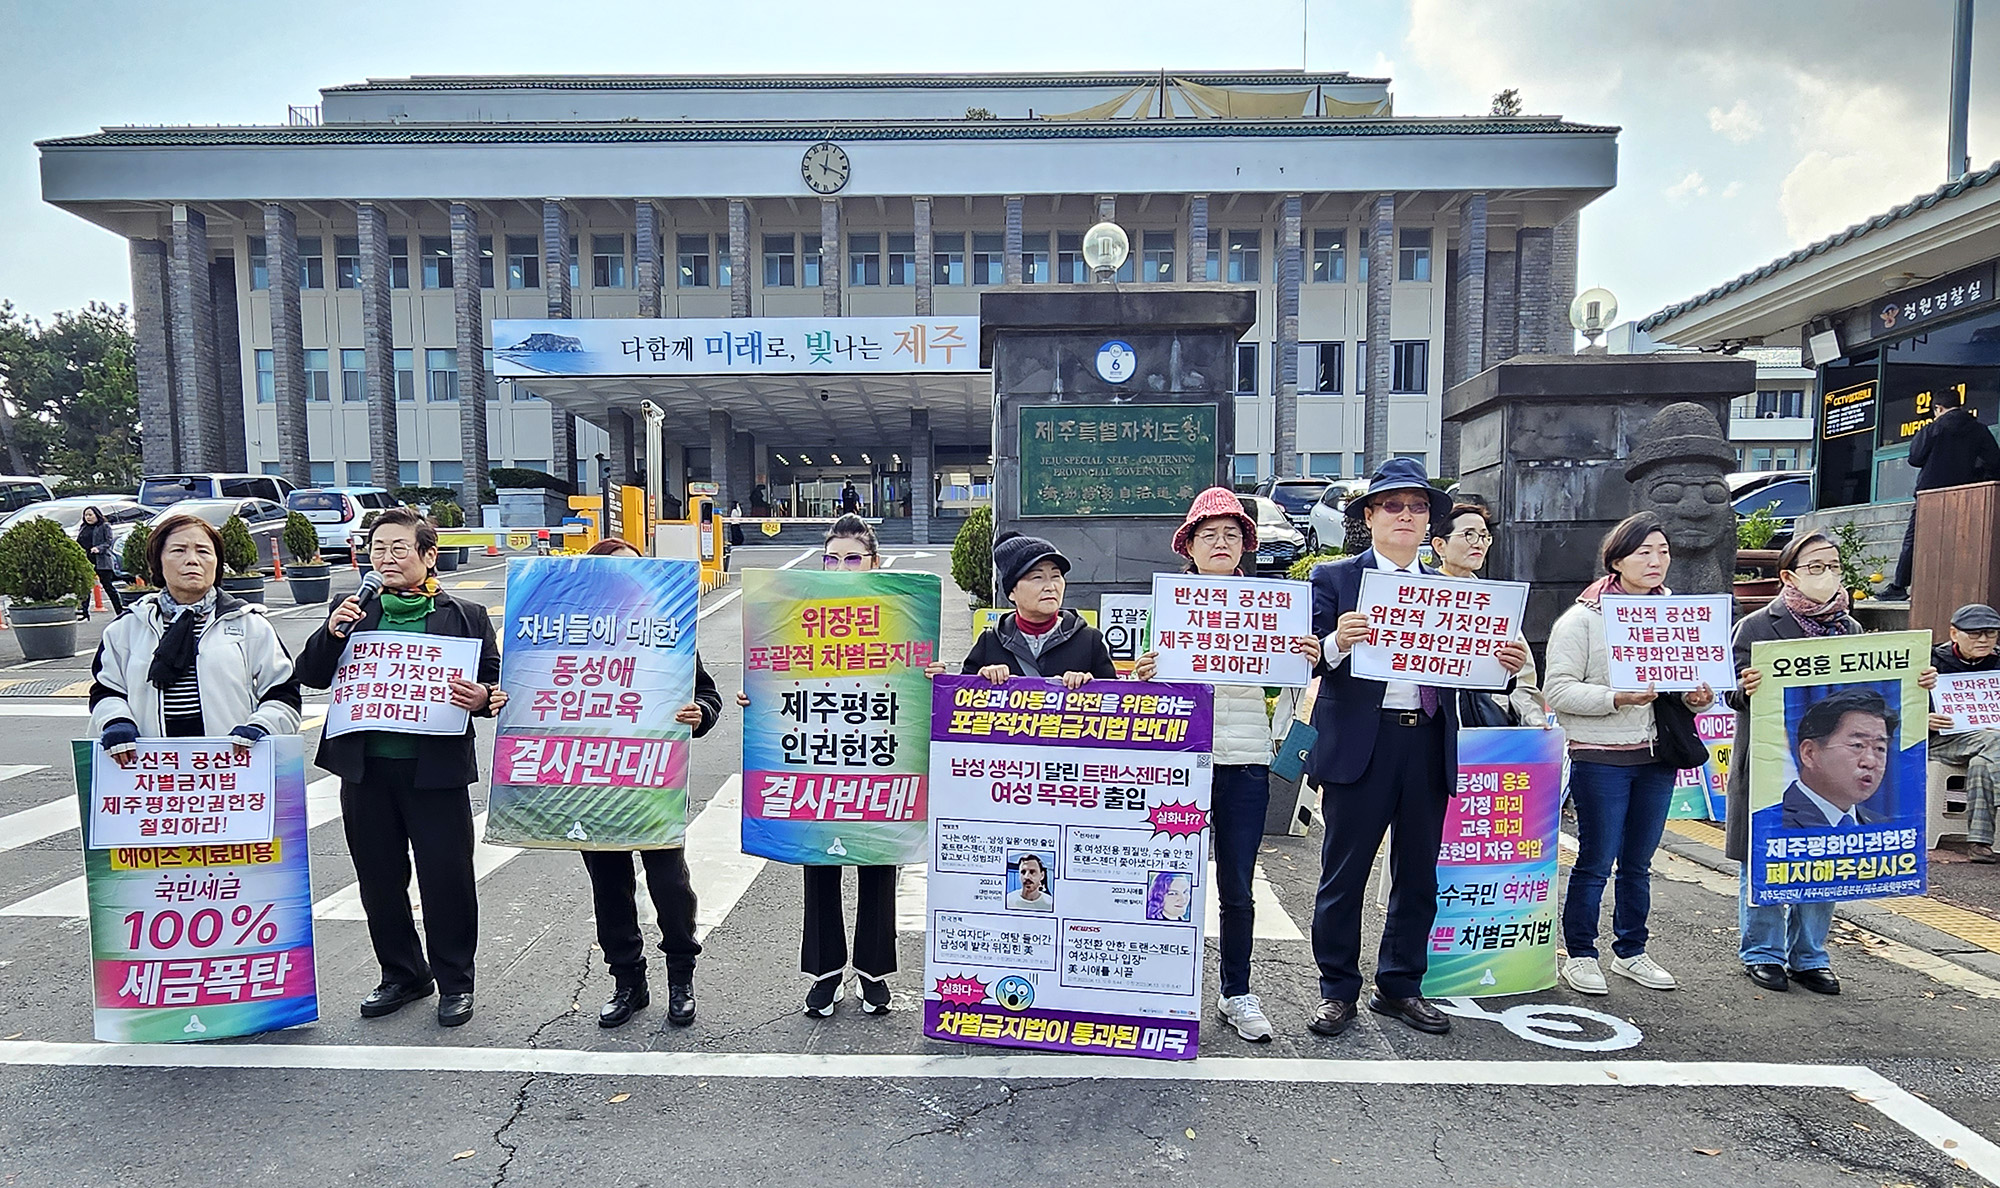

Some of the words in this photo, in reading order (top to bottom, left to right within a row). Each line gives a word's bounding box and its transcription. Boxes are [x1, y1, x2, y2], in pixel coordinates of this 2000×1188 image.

[1903, 280, 1982, 321] 청원경찰실
[620, 334, 695, 363] 다함께
[703, 329, 796, 367] 미래로,
[804, 330, 883, 366] 빛나는
[892, 323, 968, 366] 제주
[1112, 358, 1121, 371] 6
[1035, 419, 1202, 443] 제주특별자치도청
[1040, 456, 1062, 465] JEJU
[1064, 455, 1103, 465] SPECIAL
[1138, 455, 1196, 464] GOVERNING
[1053, 467, 1111, 477] PROVINCIAL
[1116, 466, 1183, 476] GOVERNMENT
[511, 535, 528, 546] 금지
[1174, 587, 1229, 606] 반신적
[1239, 589, 1293, 609] 공산화
[1398, 585, 1492, 612] 반자유민주
[801, 604, 881, 638] 위장된
[1187, 609, 1278, 632] 차별금지법
[1370, 604, 1427, 629] 위헌적
[1435, 611, 1511, 637] 거짓인권
[1616, 606, 1657, 623] 반신적
[1665, 606, 1713, 623] 공산화
[516, 612, 617, 646] 자녀들에
[627, 615, 681, 649] 대한
[1627, 626, 1701, 643] 차별금지법
[353, 642, 442, 662] 반자유민주
[1105, 625, 1144, 661] 입
[1158, 630, 1303, 654] 제주평화인권헌장
[748, 643, 815, 673] 포괄적
[820, 639, 935, 672] 차별금지법
[1192, 654, 1271, 675] 철회하라!
[1391, 652, 1473, 678] 철회하라!
[1611, 645, 1725, 663] 제주평화인권헌장
[1772, 655, 1833, 678] 오영훈
[1839, 648, 1911, 674] 도지사님
[337, 662, 378, 684] 위헌적
[387, 663, 464, 683] 거짓인권
[552, 655, 637, 688] 동성애
[1634, 665, 1700, 682] 철회하라!
[333, 681, 454, 705] 제주평화인권헌
[1952, 678, 2000, 691] 반자유민
[531, 689, 644, 724] 주입교육
[780, 690, 900, 726] 제주평화
[954, 688, 1008, 709] 여성과
[1010, 691, 1064, 712] 아동의
[1065, 693, 1121, 714] 안전을
[1120, 694, 1197, 717] 위협하는
[1941, 692, 1977, 703] 위헌적
[1942, 703, 2000, 714] 제주평화인
[350, 702, 429, 723] 철회하라!
[948, 709, 1130, 741] 포괄적차별금지법
[1130, 719, 1189, 743] 반대!
[191, 752, 252, 769] 공산화
[780, 732, 899, 767] 인권헌장
[508, 738, 674, 787] 결사반대!
[951, 758, 986, 778] 남성
[988, 759, 1042, 781] 생식기
[1044, 761, 1080, 782] 달린
[1082, 764, 1191, 787] 트랜스젠더의
[134, 772, 237, 792] 차별금지법
[1457, 771, 1499, 793] 동성애
[1501, 771, 1531, 792] 옹호
[101, 793, 266, 815] 제주평화인권헌장
[760, 774, 922, 821] 결사반대!
[990, 781, 1034, 806] 여성
[1036, 783, 1101, 808] 목욕탕
[1103, 786, 1148, 810] 출입
[1460, 795, 1491, 817] 가정
[1494, 795, 1524, 815] 파괴
[139, 816, 228, 837] 철회하라!
[1156, 811, 1202, 826] 실화냐??
[1460, 819, 1492, 838] 교육
[1494, 817, 1523, 837] 파괴
[1040, 838, 1056, 847] 출입
[1084, 844, 1120, 856] 여성전용
[1153, 848, 1171, 859] 수술
[1173, 848, 1183, 859] 안
[1184, 849, 1194, 860] 한
[1484, 841, 1515, 861] 자유
[1516, 839, 1543, 860] 억압
[1765, 828, 1918, 858] 제주평화인권헌장
[940, 852, 970, 862] 알고보니
[971, 853, 1002, 863] 성범죄자
[1073, 855, 1118, 867] 트랜스젠더
[1765, 853, 1918, 884] 폐지해주십시오
[154, 876, 242, 902] 국민세금
[1437, 882, 1498, 907] 수국민
[1503, 878, 1550, 904] 역차별
[123, 903, 279, 951] 100%
[1428, 927, 1456, 952] 쁜
[1458, 918, 1553, 950] 차별금지법
[940, 940, 968, 951] 남성에
[971, 941, 990, 952] 발칵
[992, 943, 1021, 954] 뒤집힌
[1022, 933, 1051, 945] 들어간
[1105, 940, 1126, 952] 안한
[1128, 942, 1190, 955] 트랜스젠더도
[1069, 950, 1119, 964] 여성사우나
[118, 951, 293, 1006] 세금폭탄
[1081, 966, 1110, 977] 시애틀
[936, 1010, 1069, 1043] 차별금지법이
[1071, 1021, 1140, 1050] 통과된
[1141, 1028, 1189, 1054] 미국
